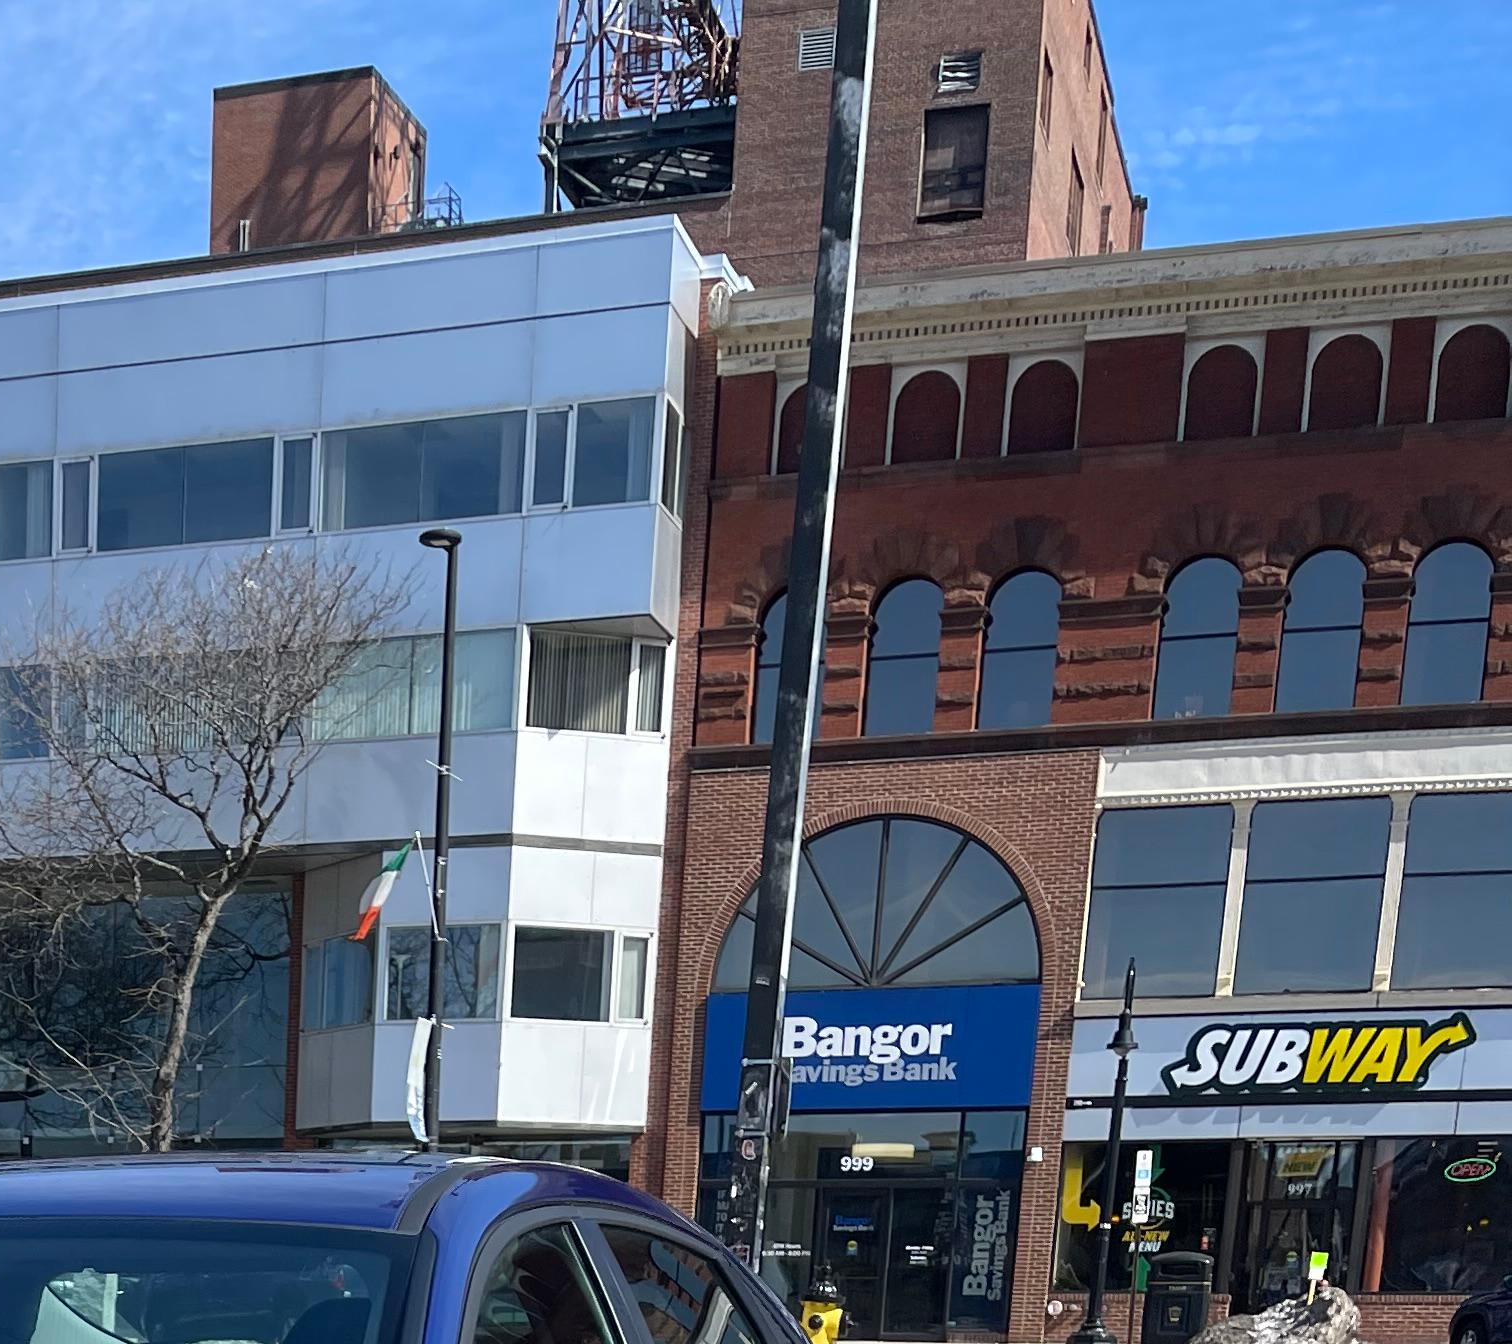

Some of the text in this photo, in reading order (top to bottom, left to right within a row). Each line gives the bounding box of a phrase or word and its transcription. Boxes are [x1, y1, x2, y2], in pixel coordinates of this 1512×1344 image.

[781, 1016, 953, 1064] Bangor
[1170, 1020, 1470, 1088] SUBWAY
[791, 1056, 958, 1087] avings Bank
[840, 1156, 874, 1172] 999
[1451, 1163, 1492, 1177] OPEN
[1288, 1183, 1313, 1196] 997
[962, 1194, 996, 1296] Bangor
[987, 1189, 1011, 1302] Savings Bank
